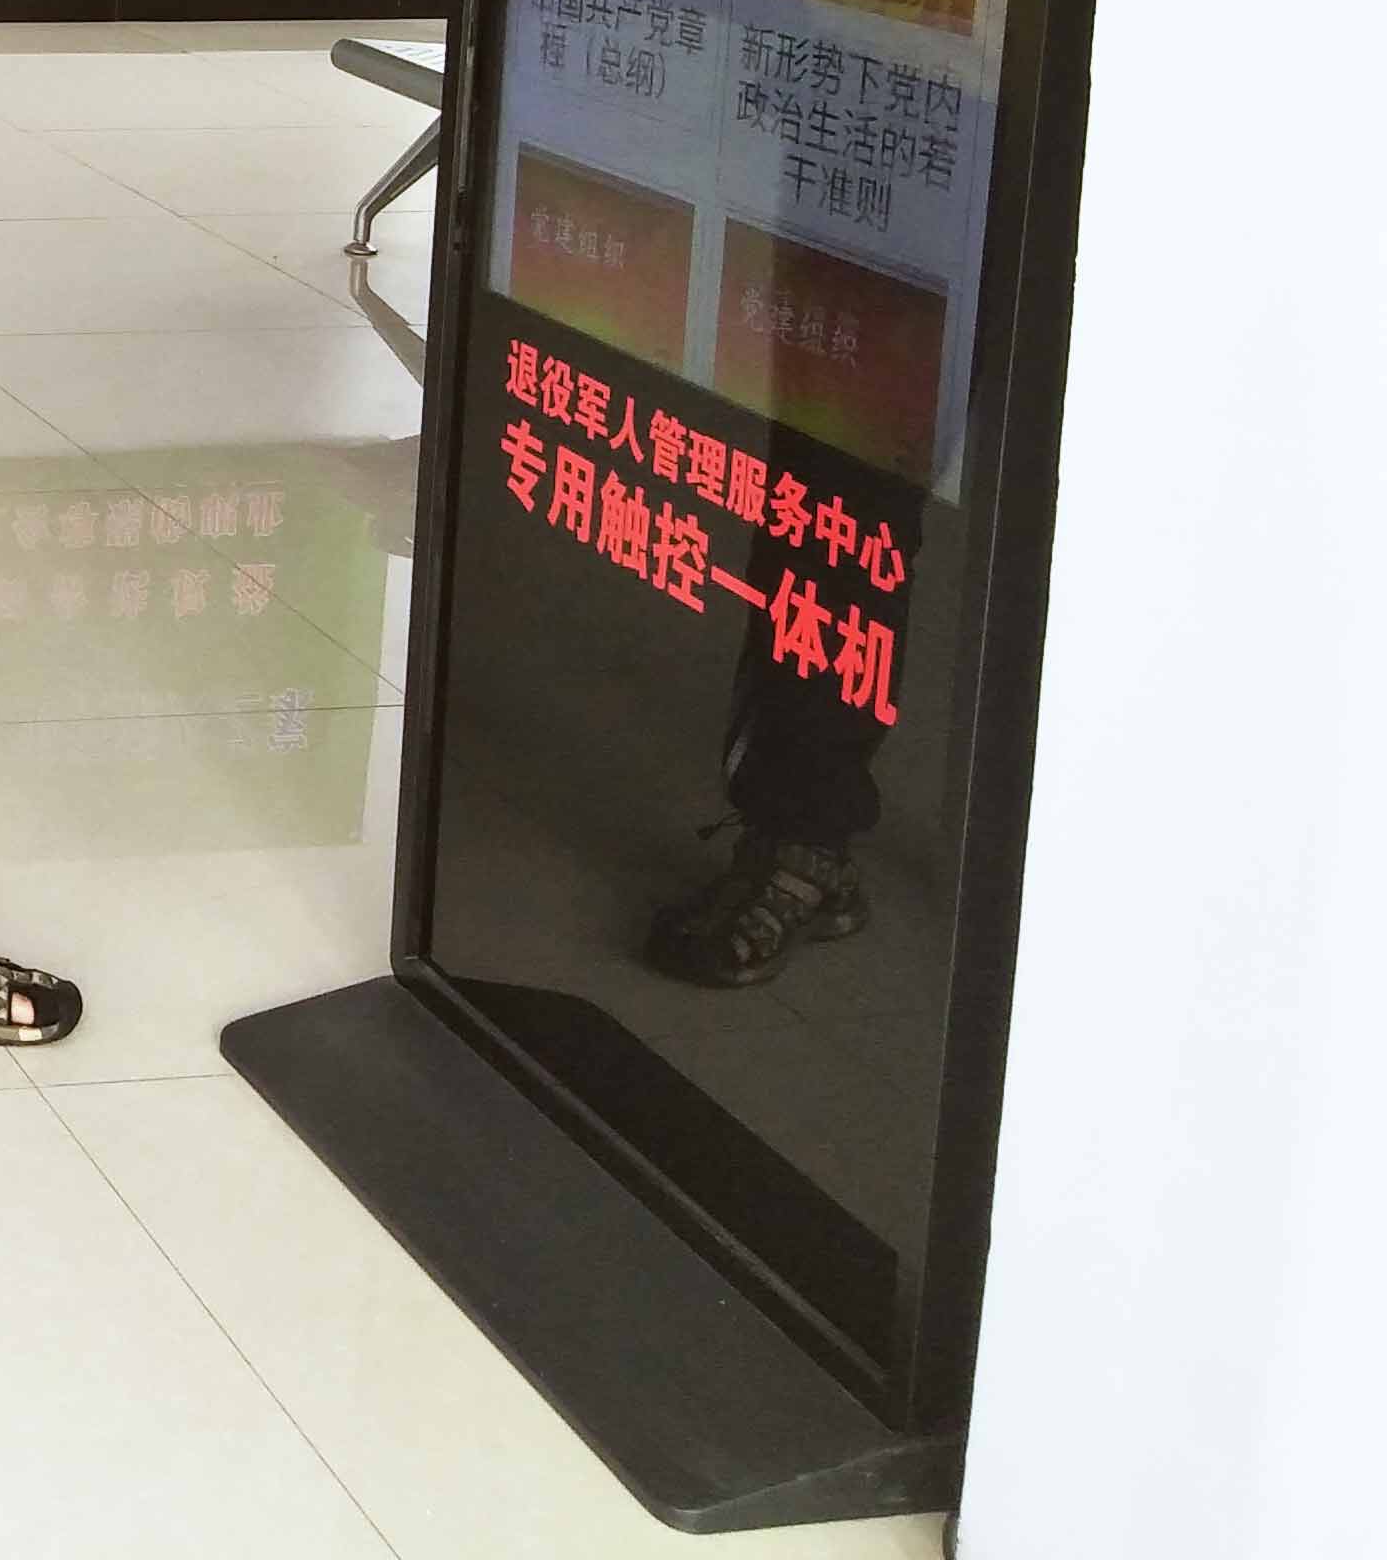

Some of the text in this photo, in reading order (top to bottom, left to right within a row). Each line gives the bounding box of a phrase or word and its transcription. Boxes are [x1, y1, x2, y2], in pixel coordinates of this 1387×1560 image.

[738, 23, 963, 128] 新形势下党内
[737, 80, 958, 192] 政治生活的若
[530, 206, 628, 270] 党建组织
[784, 153, 892, 233] 干准则
[740, 288, 860, 368] 党建组织
[506, 339, 906, 593] 退役军人管理服务中心
[500, 420, 897, 727] 专用触控一体机
